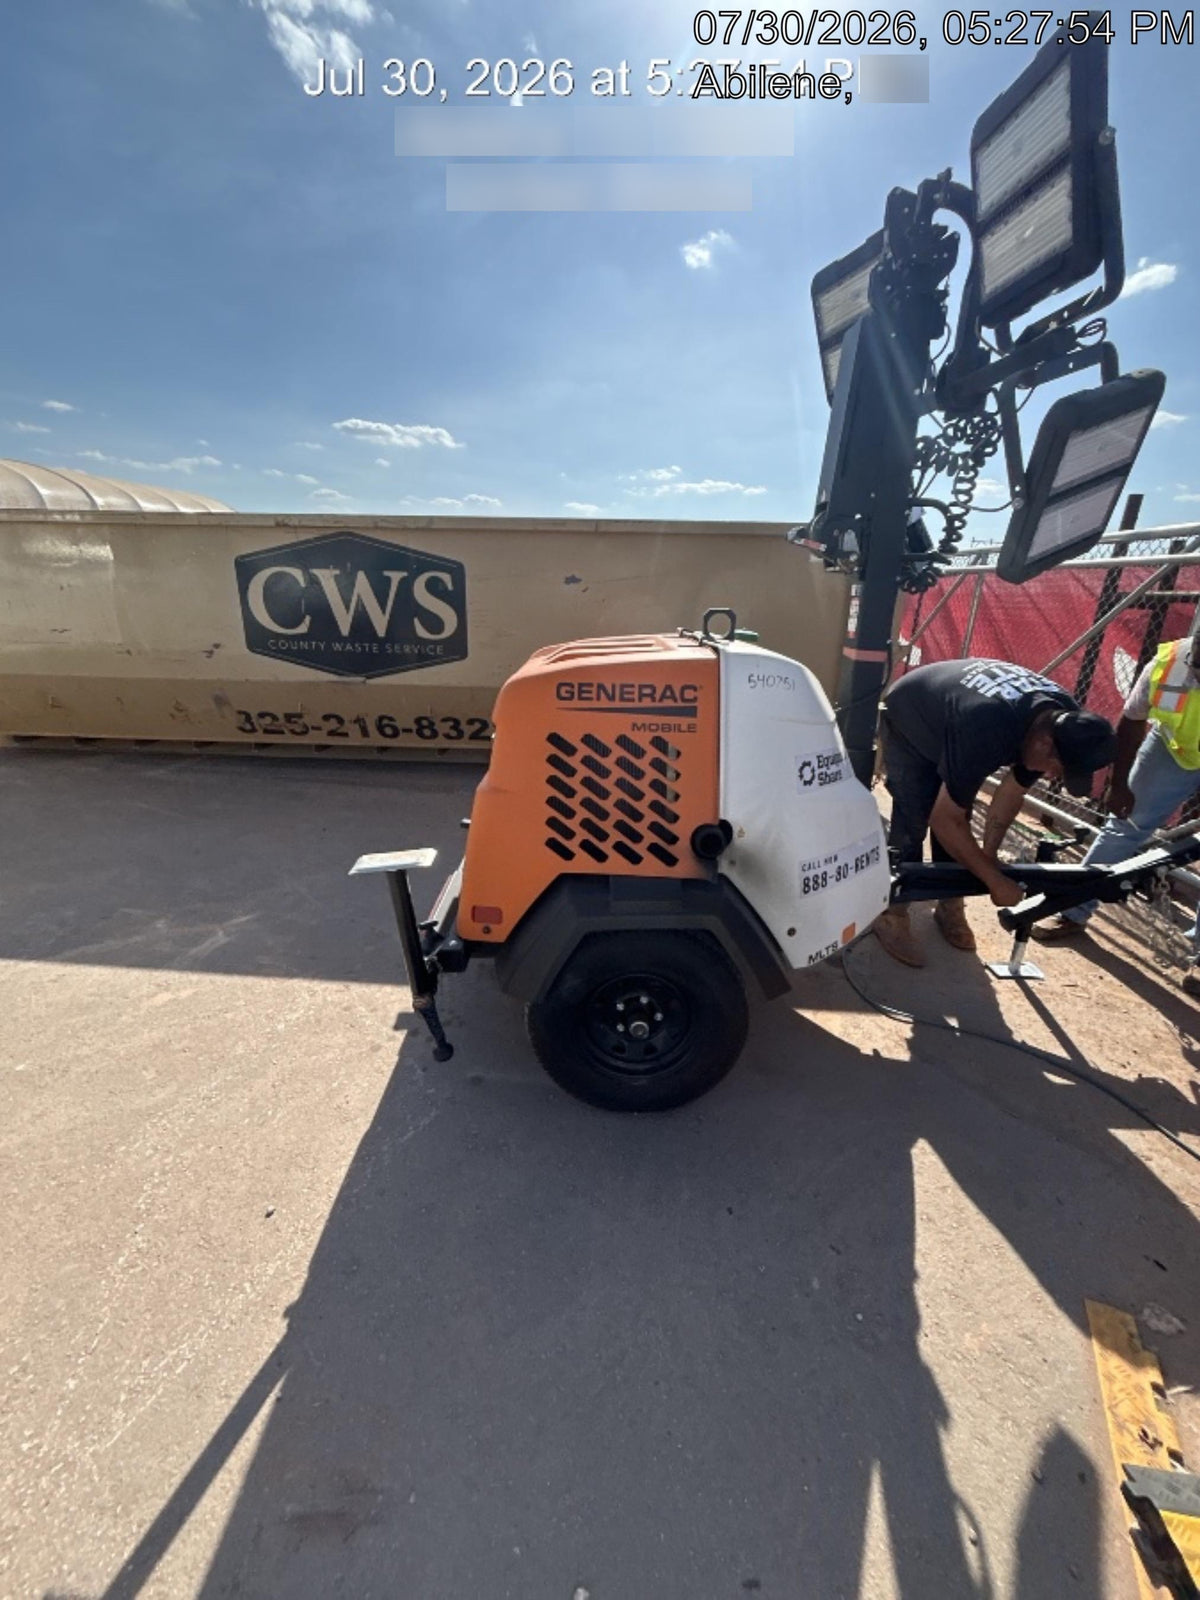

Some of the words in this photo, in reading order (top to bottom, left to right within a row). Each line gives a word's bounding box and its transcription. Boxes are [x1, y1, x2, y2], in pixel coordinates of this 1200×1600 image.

[247, 566, 458, 640] CWS
[267, 639, 326, 650] COUNTY
[332, 641, 379, 653] WASTE
[386, 643, 444, 656] SERVICE
[556, 682, 698, 703] GENERAC
[236, 710, 492, 741] 325-216-832
[631, 722, 697, 733] MOBILE
[816, 753, 844, 770] Equ
[801, 861, 822, 873] CALL
[802, 845, 880, 894] 888-80-RENTS
